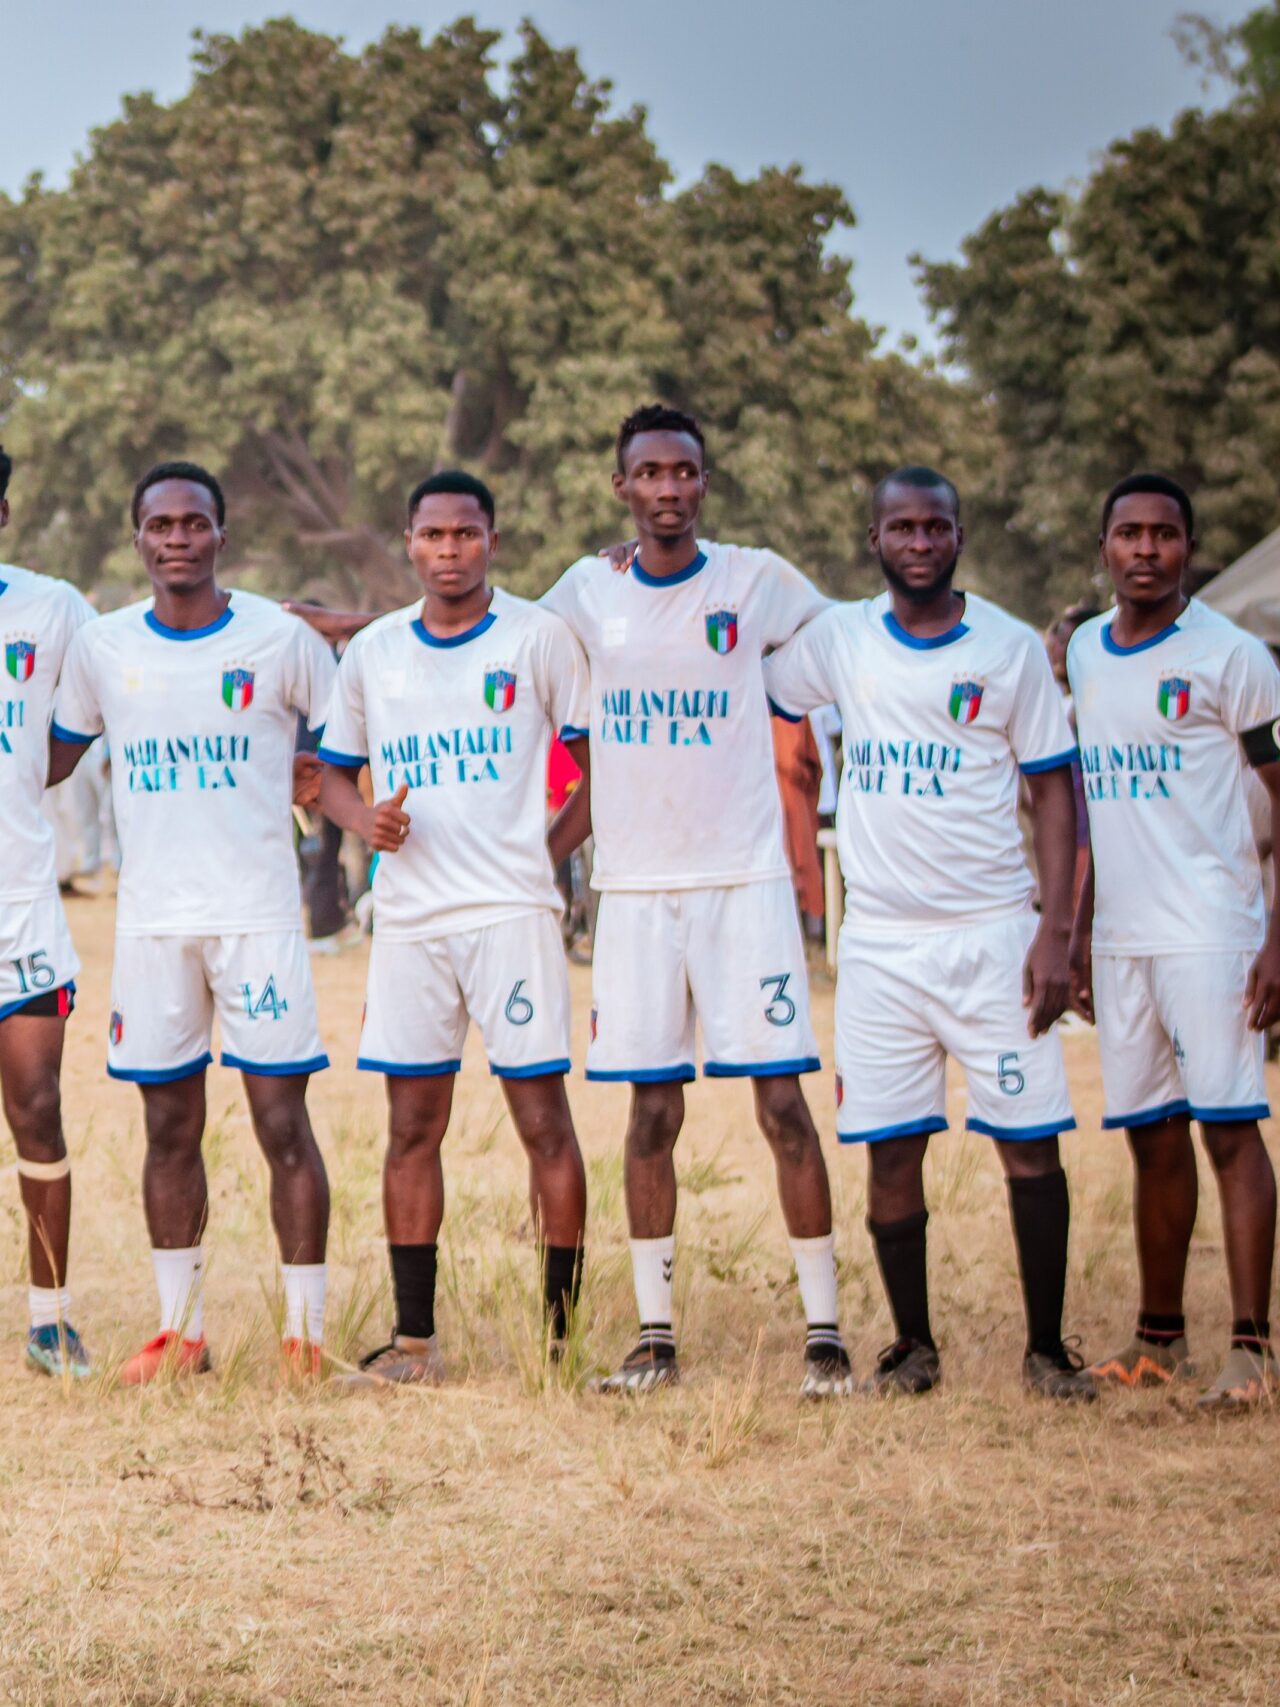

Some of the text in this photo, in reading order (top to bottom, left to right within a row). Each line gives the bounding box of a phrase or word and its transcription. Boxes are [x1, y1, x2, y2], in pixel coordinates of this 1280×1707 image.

[381, 726, 512, 767] MAILANTARKI
[670, 720, 712, 746] F.A
[198, 764, 236, 790] F.A
[457, 757, 500, 783] F.A
[904, 771, 944, 797] F.A
[1130, 774, 1170, 800] F.A
[9, 949, 56, 995] 15
[239, 974, 288, 1021] 14
[505, 979, 533, 1026] 6
[759, 972, 796, 1027] 3
[997, 1052, 1025, 1096] 5
